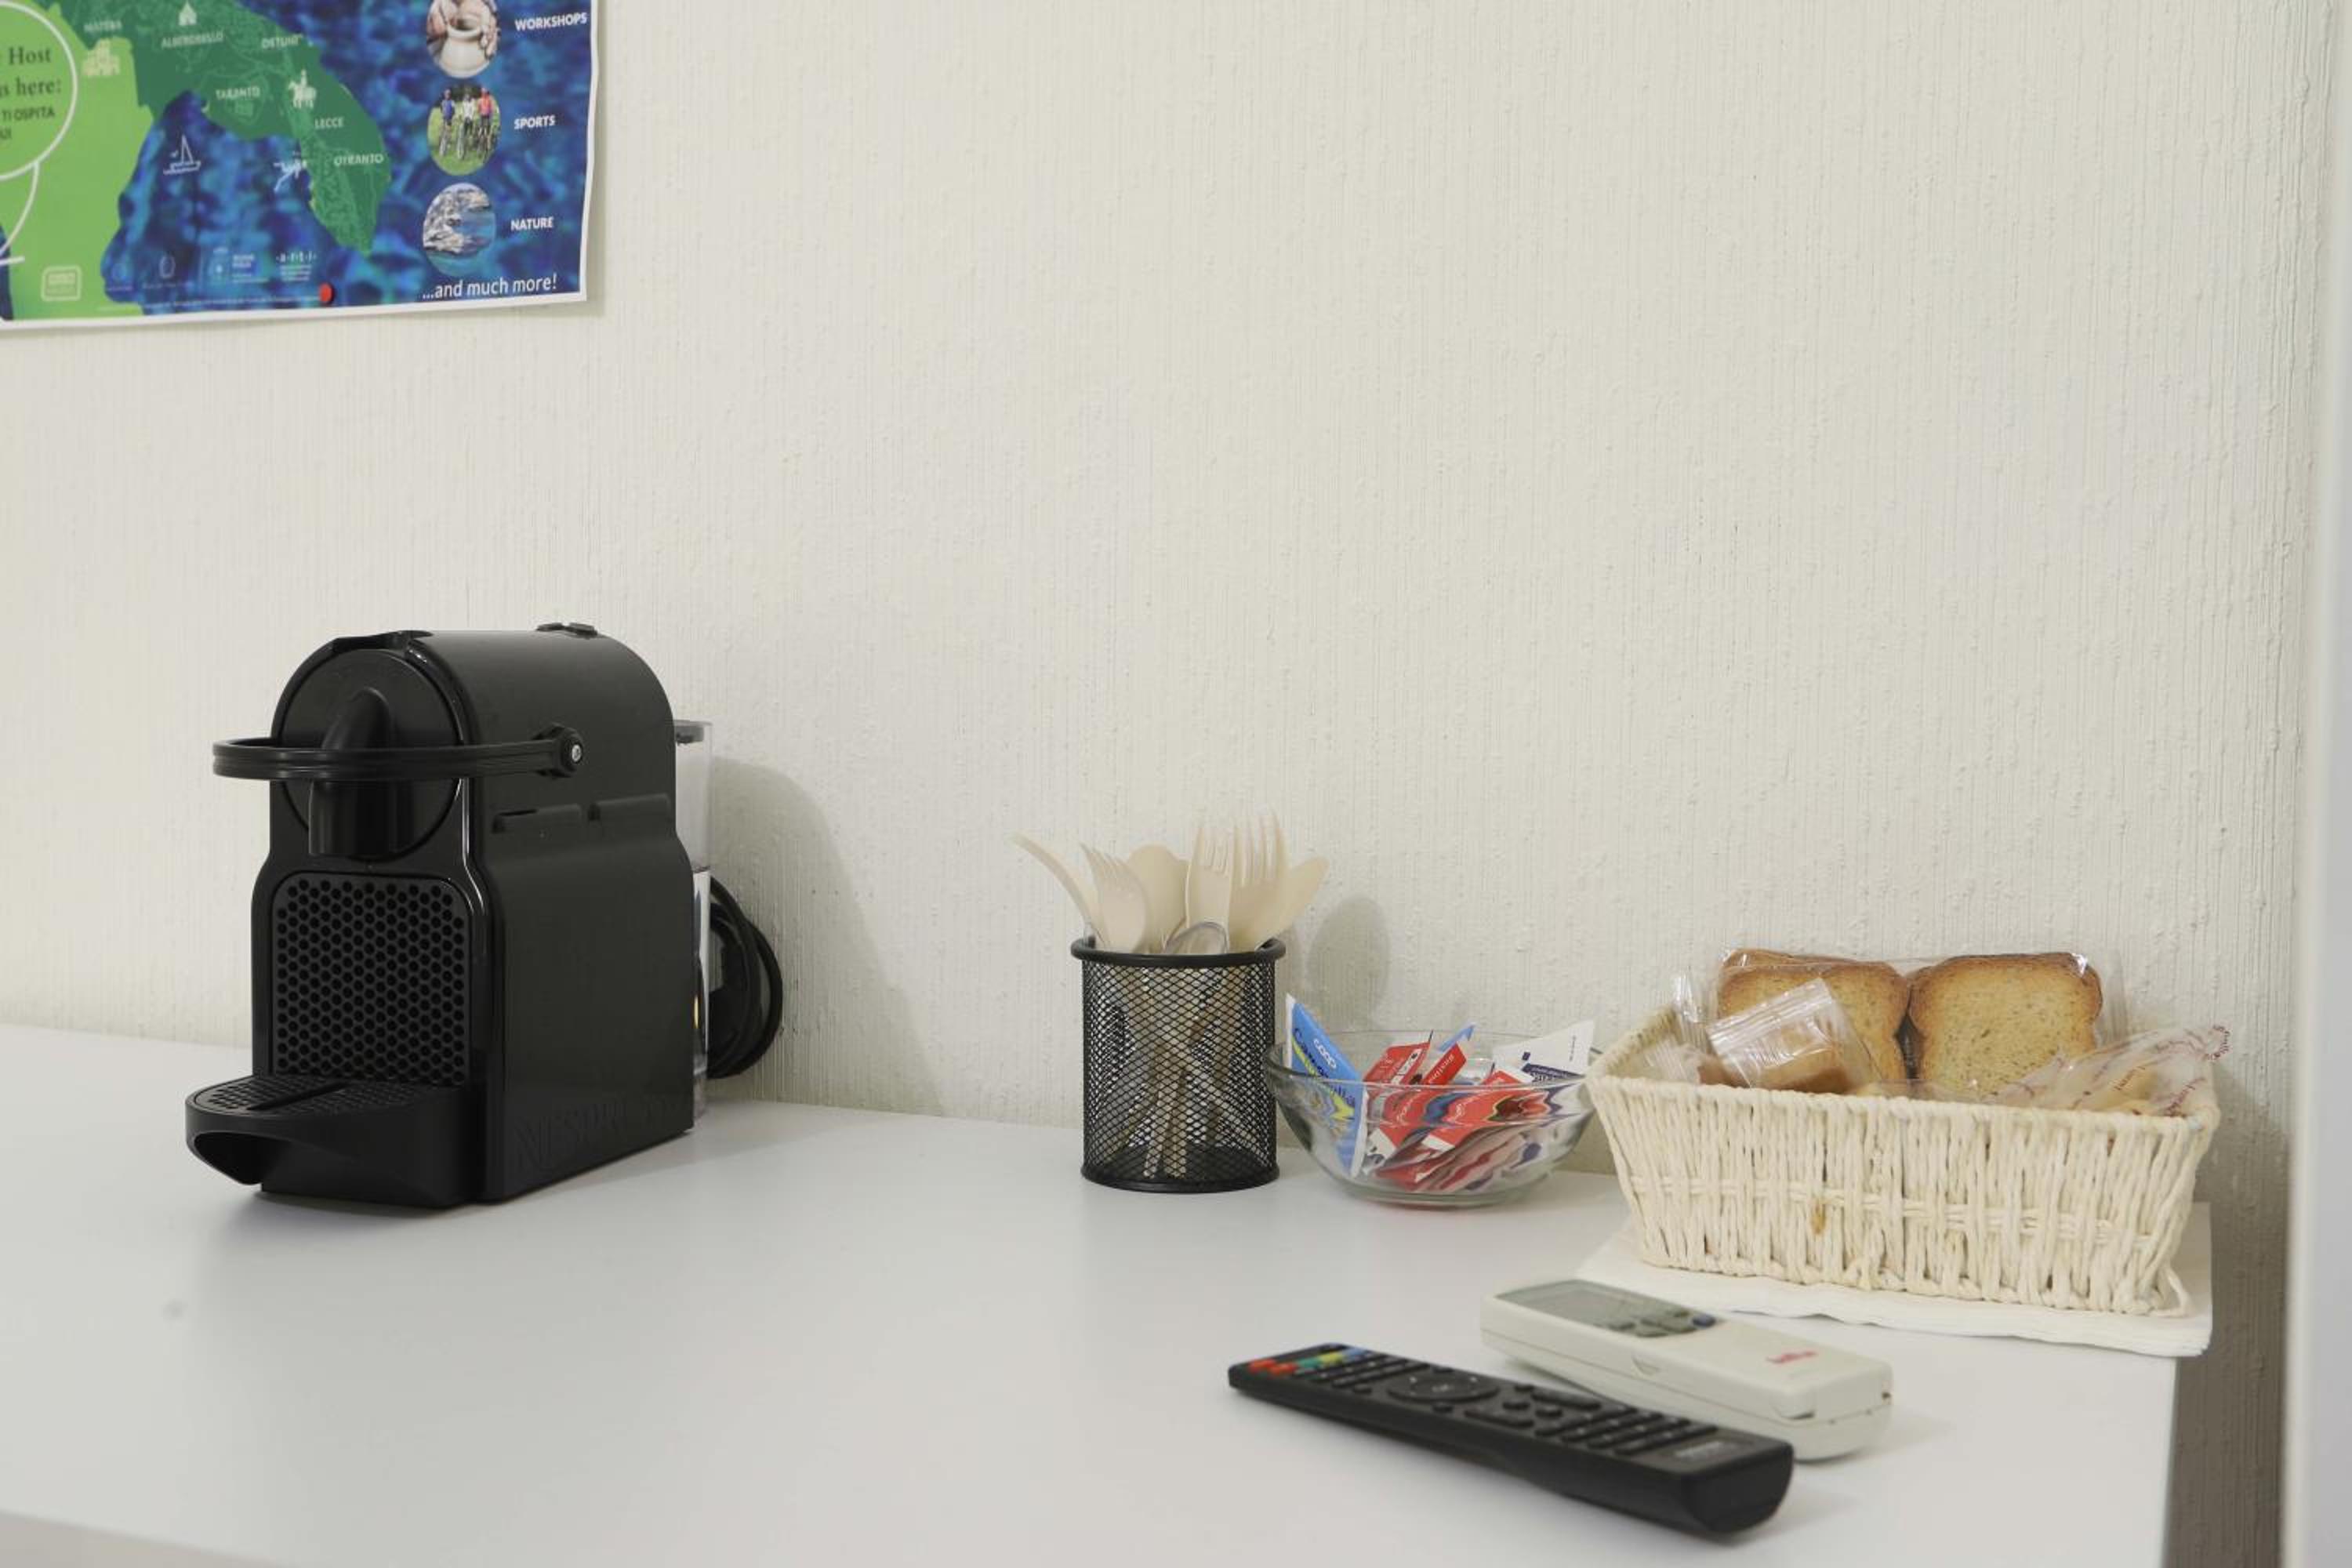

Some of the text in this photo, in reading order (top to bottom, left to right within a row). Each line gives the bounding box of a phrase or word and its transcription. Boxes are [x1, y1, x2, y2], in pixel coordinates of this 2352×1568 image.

[514, 12, 588, 31] WORKSHOPS
[9, 46, 51, 65] Host
[16, 76, 62, 95] here:
[314, 117, 344, 129] LECCE
[514, 115, 556, 129] SPORTS
[510, 216, 554, 231] NATURE
[422, 272, 558, 299] ...and much more!
